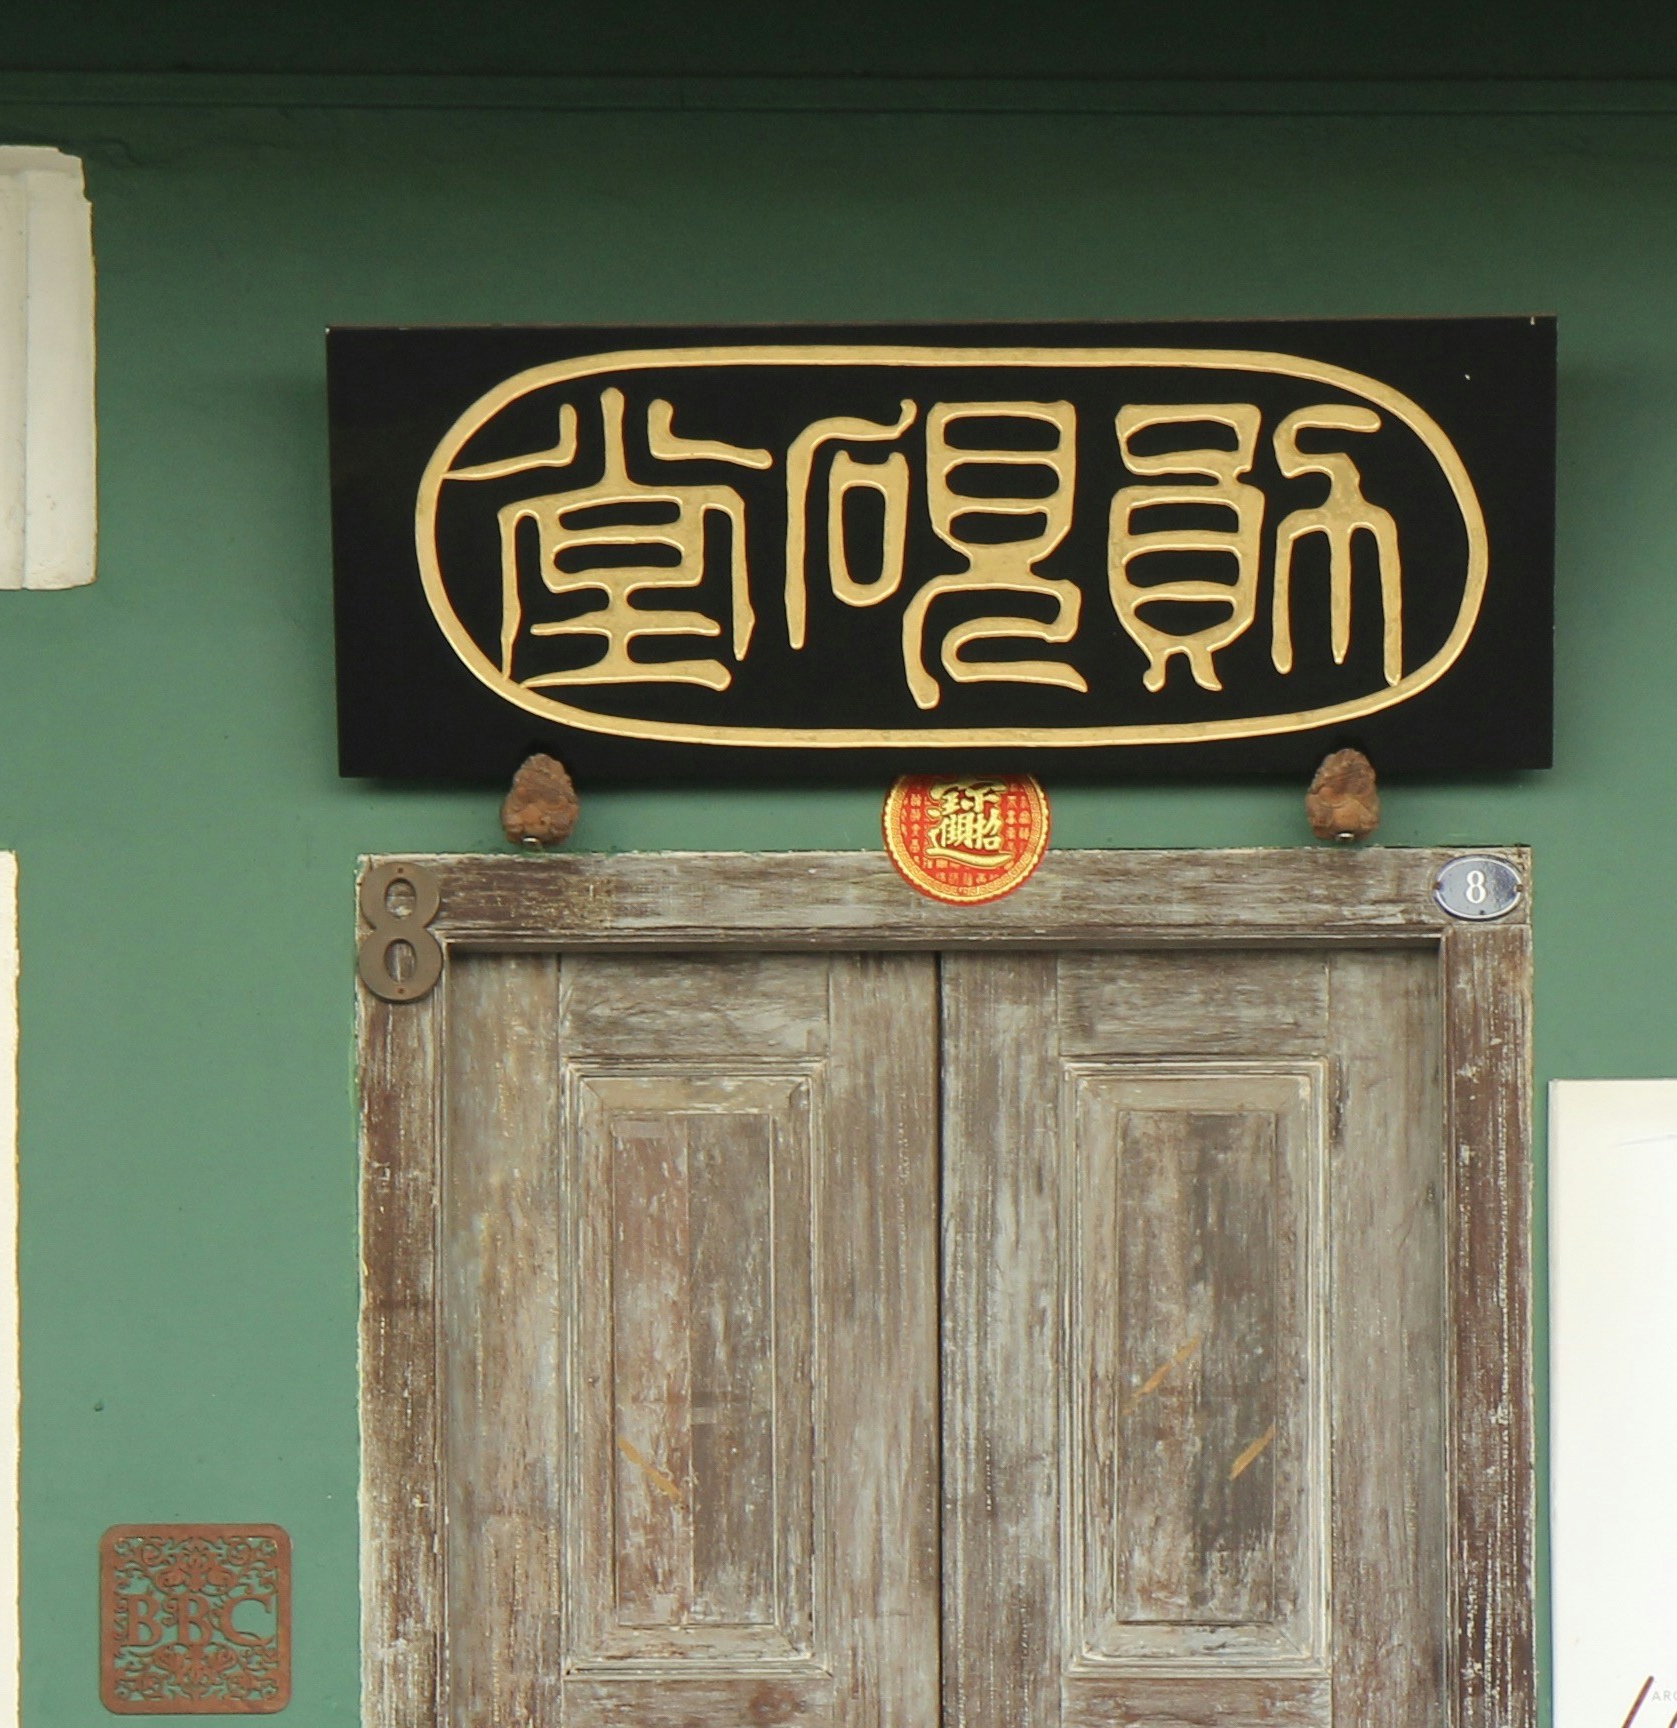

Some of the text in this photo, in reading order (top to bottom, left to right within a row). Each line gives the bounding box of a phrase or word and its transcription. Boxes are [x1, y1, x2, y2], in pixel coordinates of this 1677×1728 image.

[1465, 870, 1487, 904] 8
[359, 861, 444, 1002] 8
[123, 1592, 275, 1647] BBC
